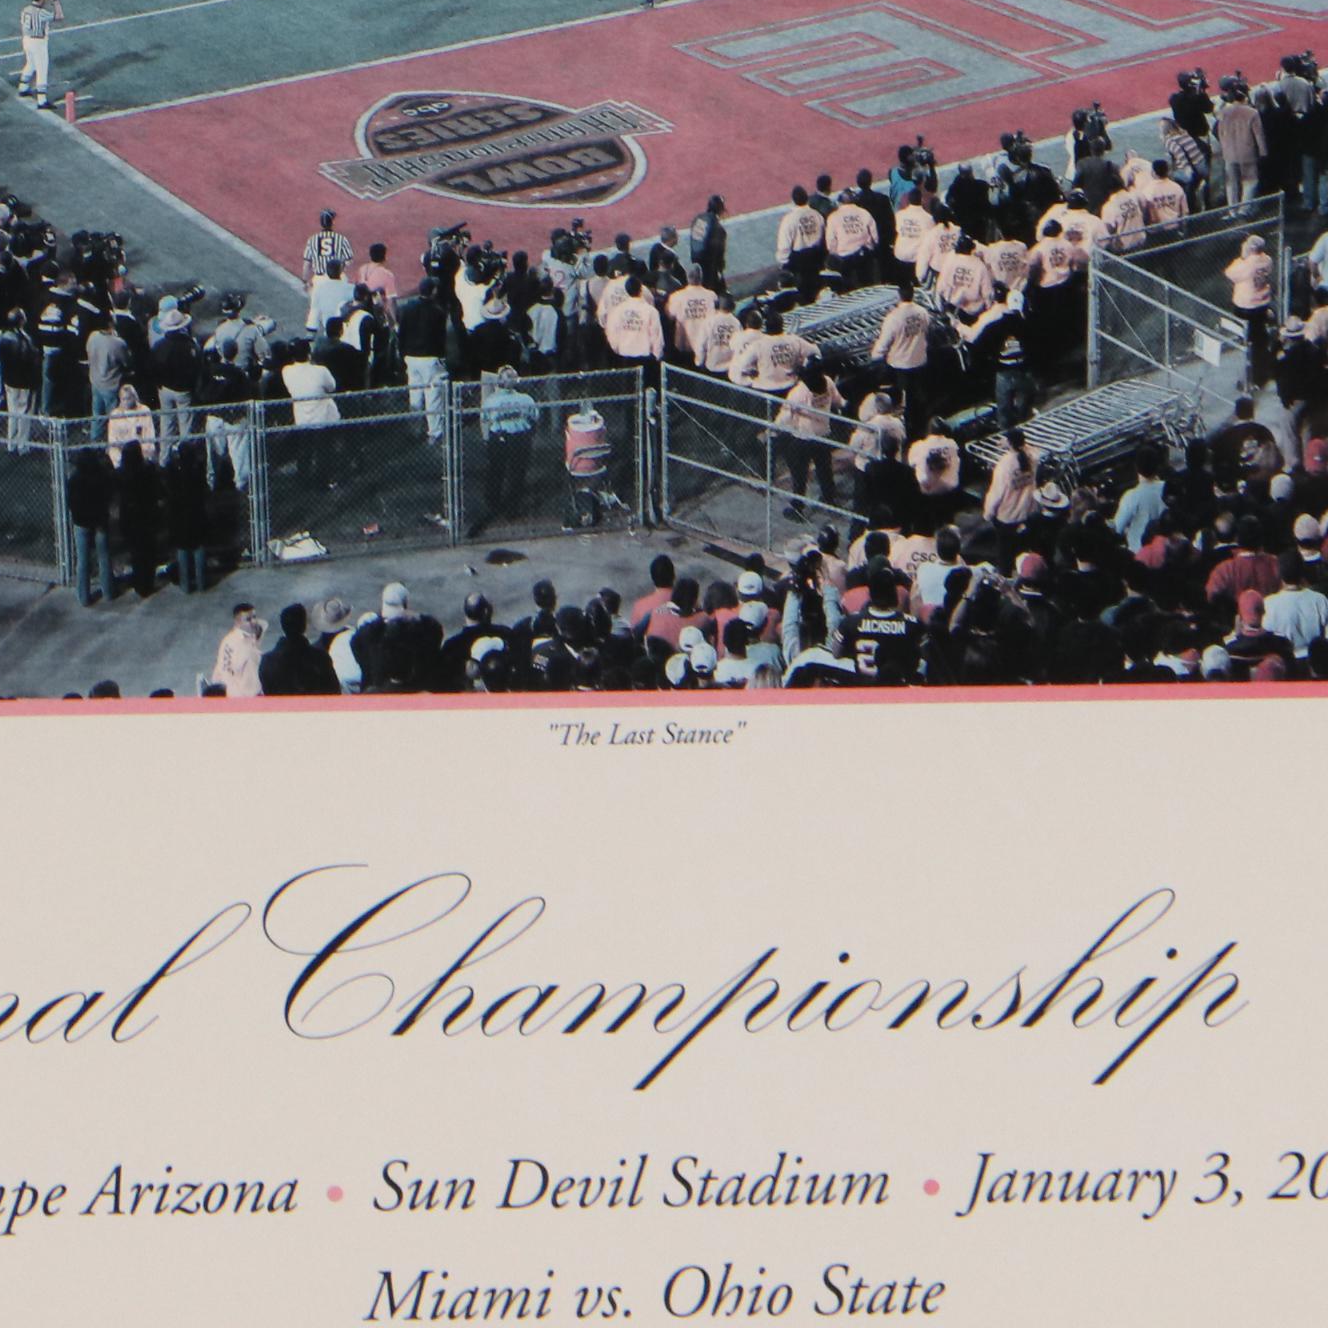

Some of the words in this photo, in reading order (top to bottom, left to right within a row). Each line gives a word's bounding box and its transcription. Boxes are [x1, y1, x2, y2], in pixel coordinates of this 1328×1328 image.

[376, 104, 541, 151] SERIES
[448, 146, 616, 193] BOWL
[320, 237, 334, 259] S
[911, 552, 937, 562] CSC
[857, 619, 906, 634] JACKSON
[549, 722, 601, 746] "The
[609, 723, 655, 746] Last
[662, 720, 747, 745] Stance"
[261, 863, 1250, 1092] Championship
[79, 1162, 299, 1218] Arizona
[373, 1158, 477, 1212] Sun
[497, 1153, 649, 1210] Devil
[662, 1152, 890, 1209] Stadium
[954, 1151, 1177, 1221] January
[1193, 1150, 1245, 1208] 3,
[362, 1269, 554, 1322] Miami
[572, 1285, 633, 1320] vs.
[662, 1264, 793, 1319] Ohio
[813, 1263, 947, 1317] State
